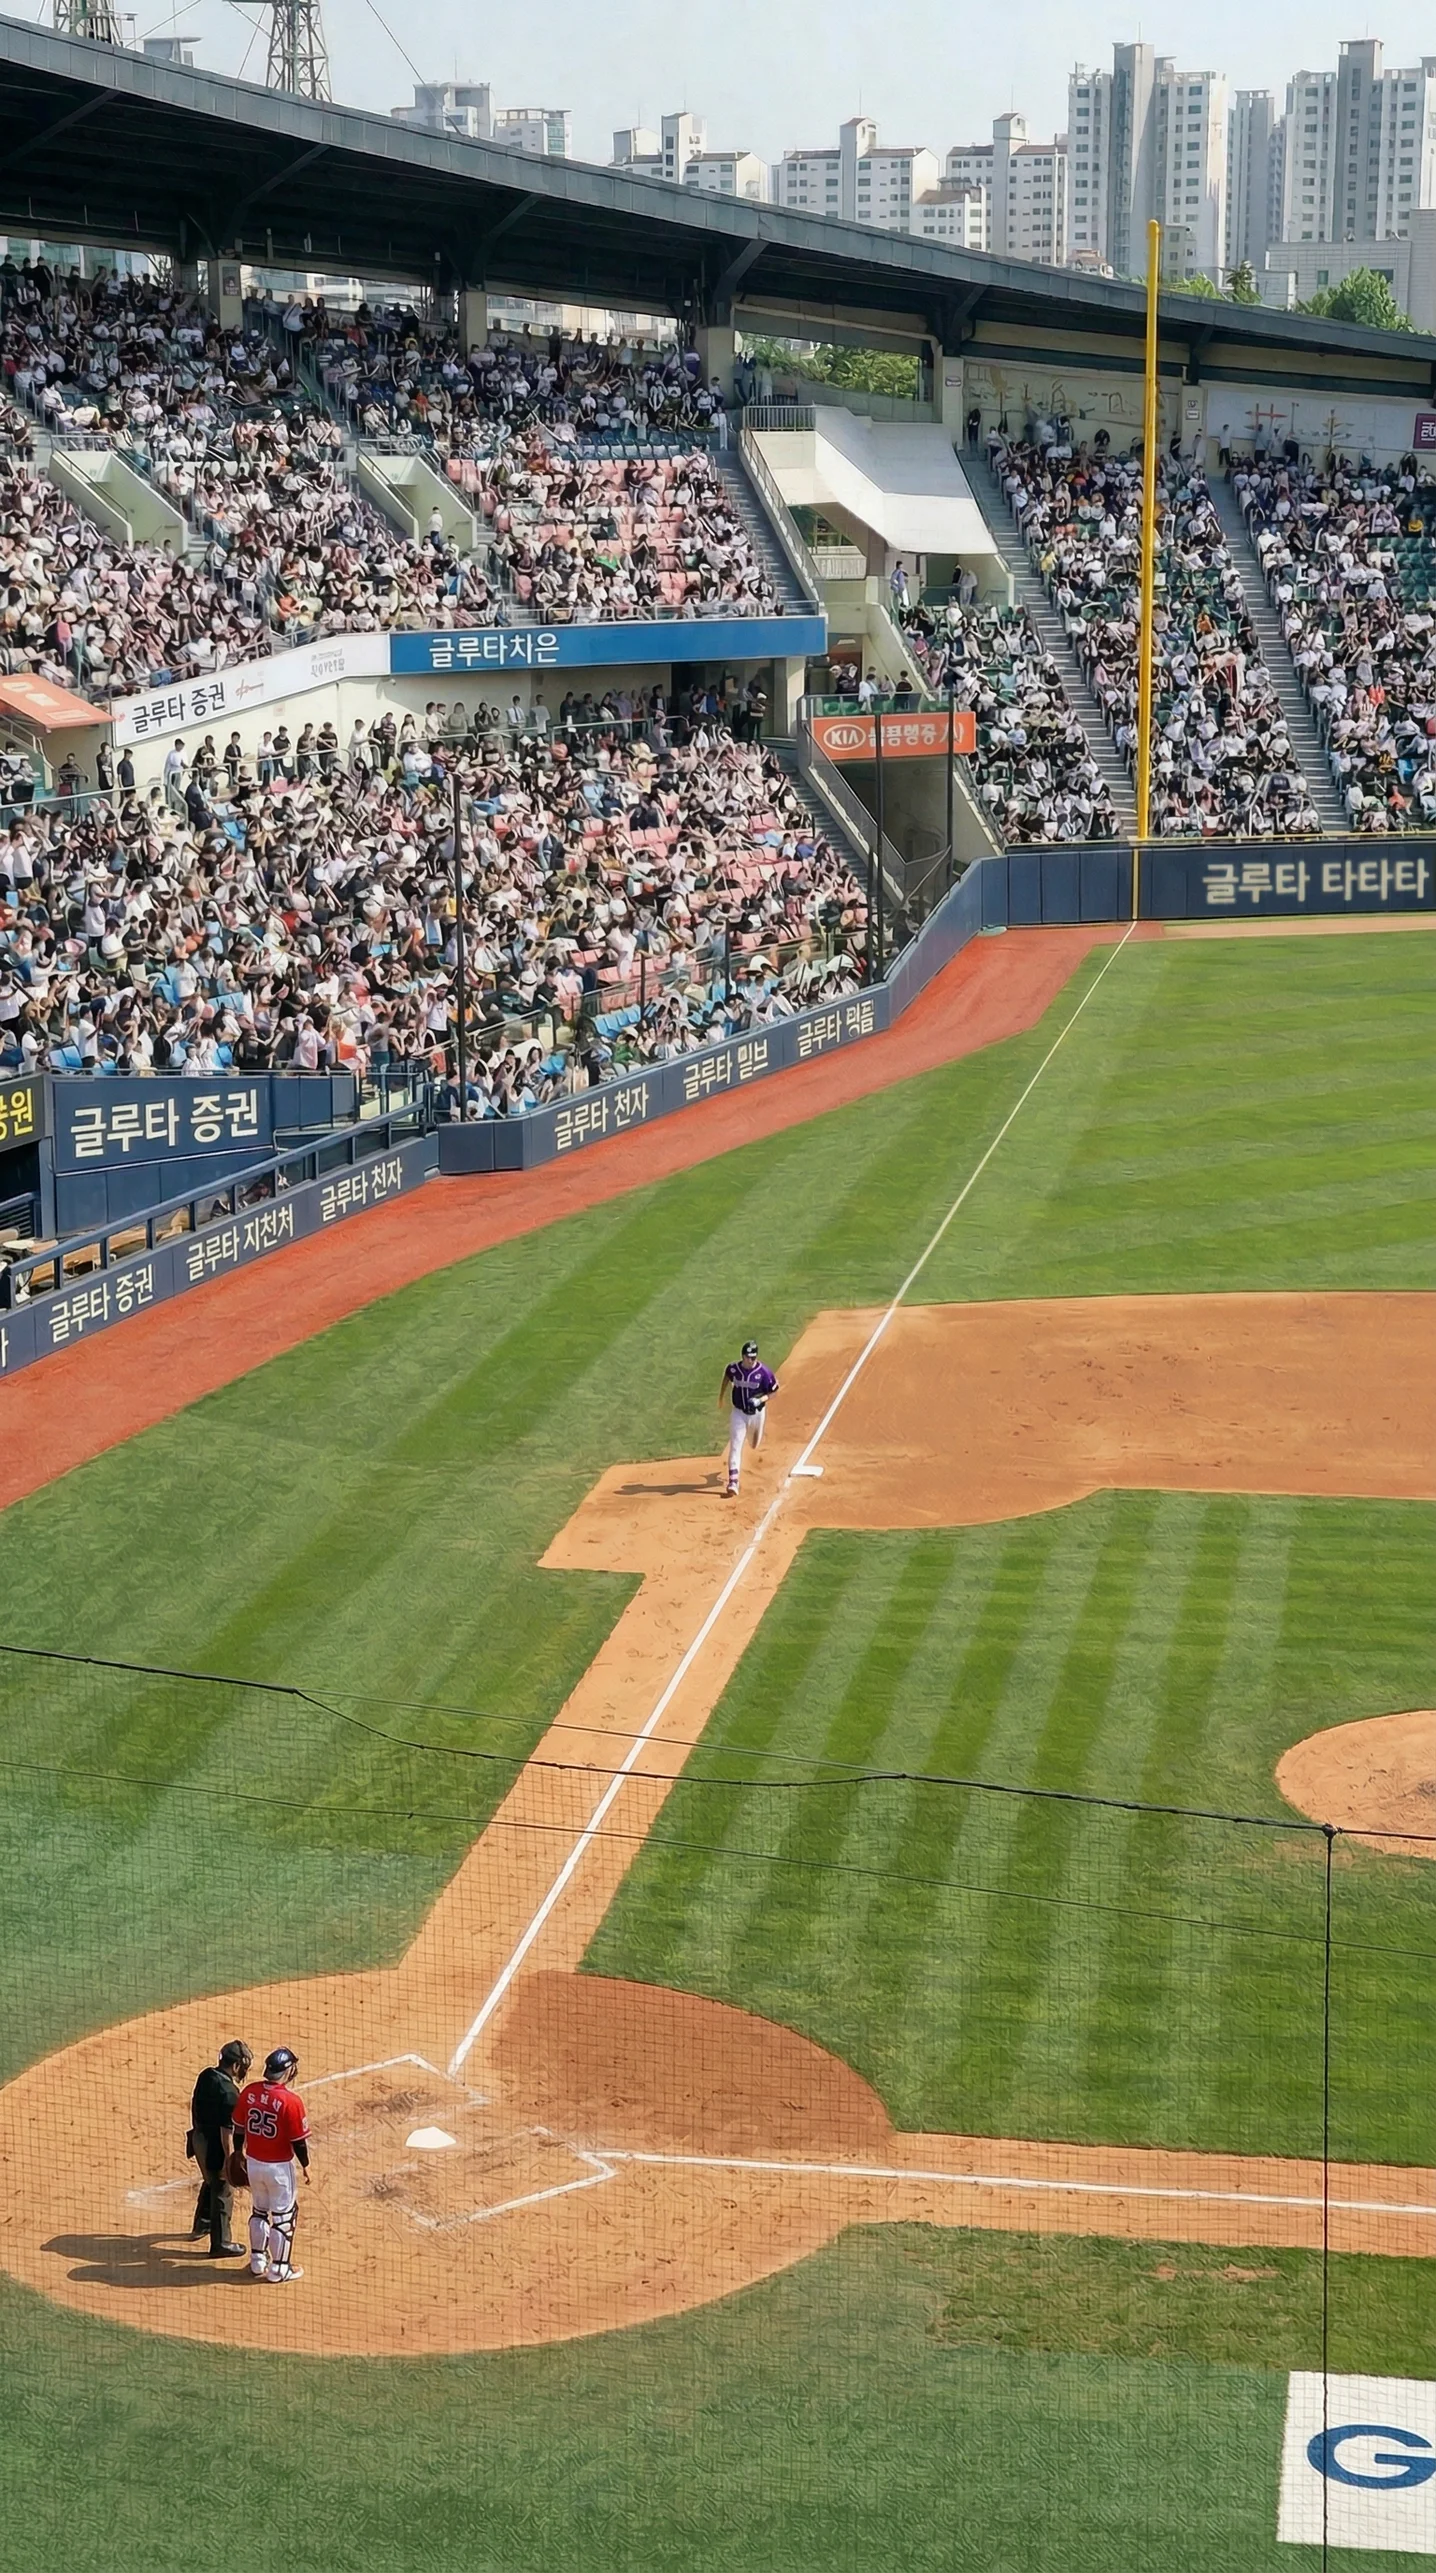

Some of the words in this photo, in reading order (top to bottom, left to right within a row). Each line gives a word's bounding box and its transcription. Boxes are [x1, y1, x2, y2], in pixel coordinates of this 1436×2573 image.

[429, 632, 559, 669] 글루타차은
[132, 693, 186, 734] 글루타
[190, 681, 226, 717] 증권
[831, 730, 859, 745] KIA
[1202, 860, 1311, 905] 글루타
[1322, 858, 1430, 901] 타타타
[798, 1010, 842, 1057] 글루타
[683, 1049, 733, 1101] 글루타
[70, 1097, 180, 1158] 글루타
[190, 1089, 259, 1143] 증권
[554, 1097, 609, 1151] 글루타
[614, 1081, 650, 1128] 천자
[320, 1170, 369, 1222] 글루타
[371, 1156, 403, 1200] 천자
[185, 1226, 240, 1282] 글루타
[49, 1282, 110, 1344] 글루타
[115, 1263, 154, 1313] 증권
[247, 2107, 278, 2139] 25
[1307, 2424, 1436, 2490] G
